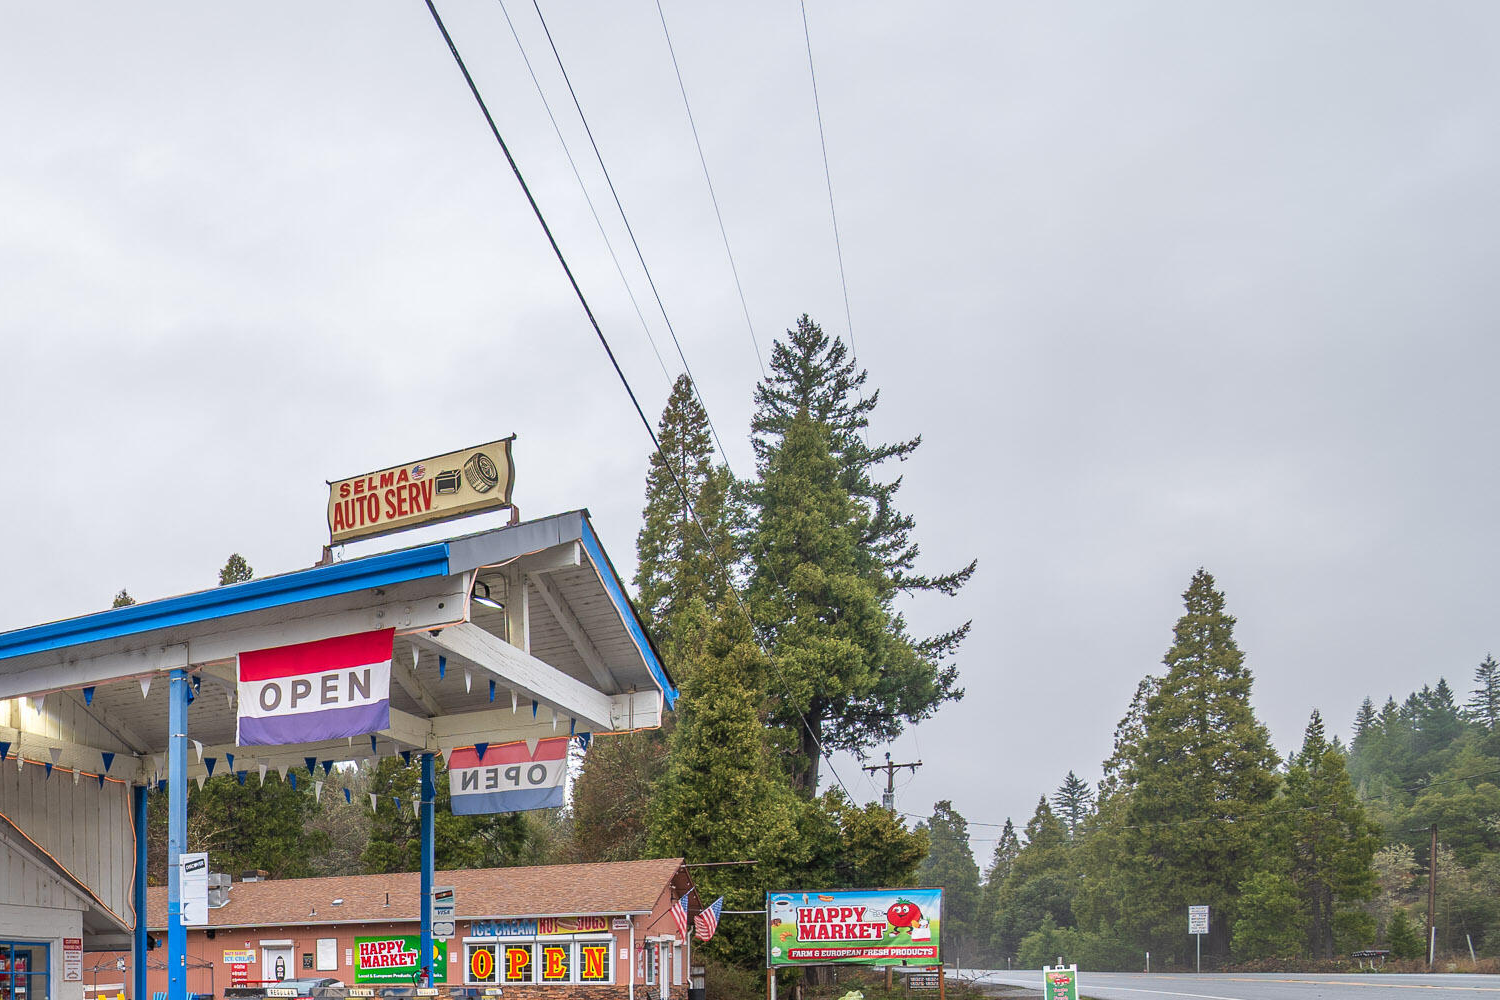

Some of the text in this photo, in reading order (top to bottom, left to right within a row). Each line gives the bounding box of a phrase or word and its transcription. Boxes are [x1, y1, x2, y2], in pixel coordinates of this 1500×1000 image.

[339, 469, 409, 499] SELMA
[333, 478, 434, 532] AUTO SERV
[258, 668, 372, 712] OPEN
[799, 907, 867, 923] HAPPY
[472, 916, 606, 937] ICE CREAM HOT DOGS
[799, 922, 887, 940] MARKET
[360, 940, 404, 956] HAPPY
[821, 949, 862, 957] EUROPEAN
[890, 947, 934, 956] PRODUCTS
[360, 952, 417, 968] MARKET
[471, 947, 607, 979] OPEN
